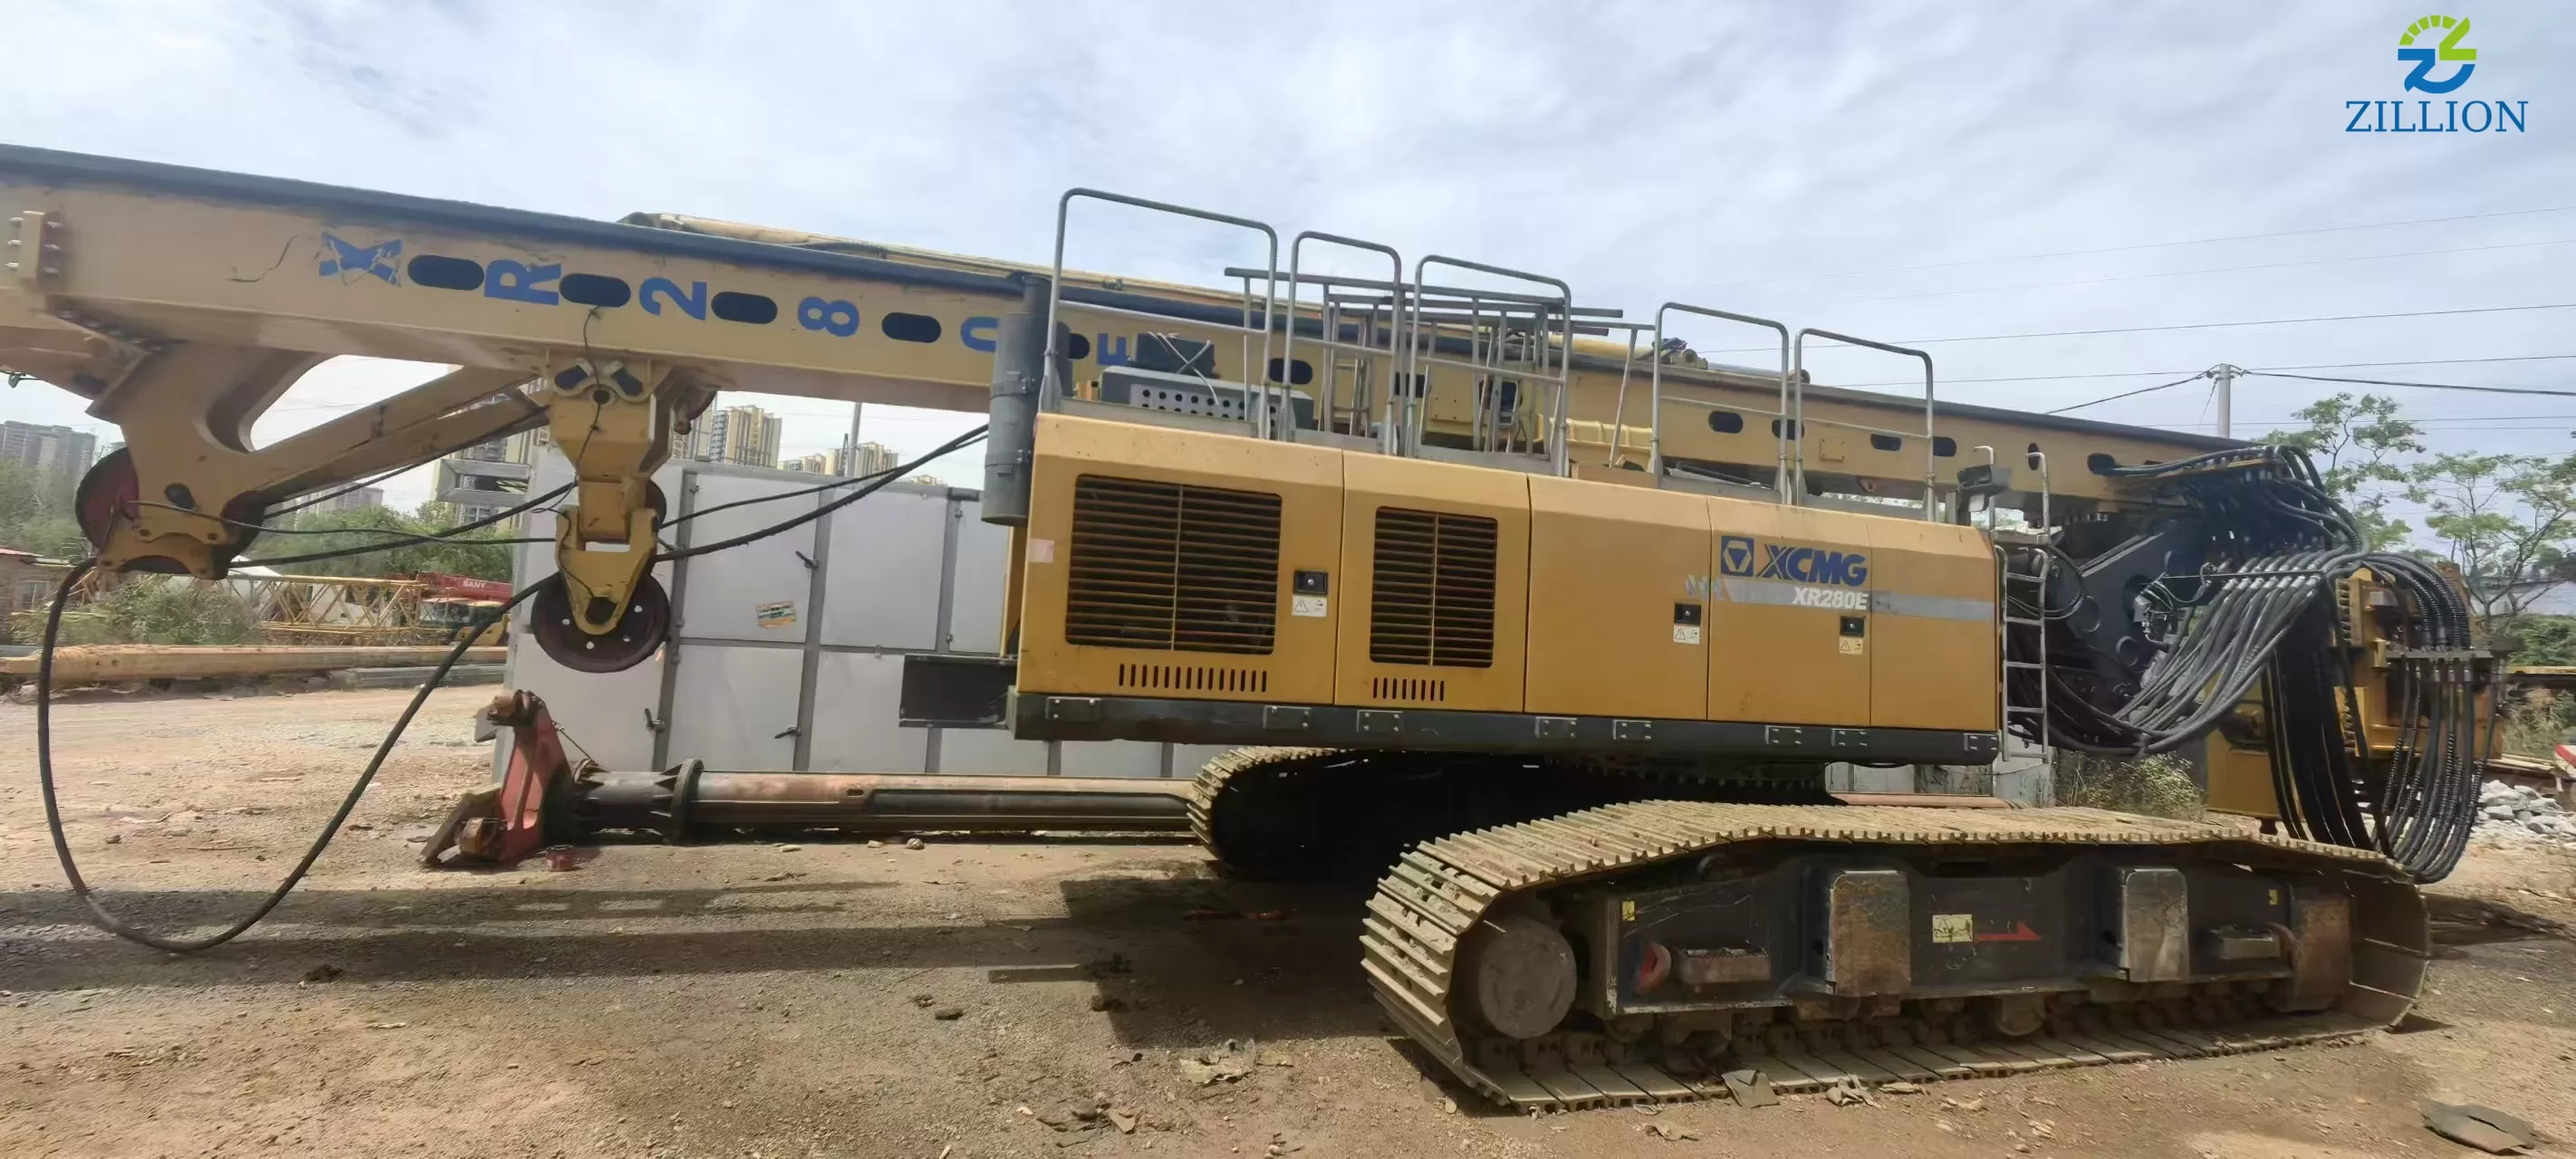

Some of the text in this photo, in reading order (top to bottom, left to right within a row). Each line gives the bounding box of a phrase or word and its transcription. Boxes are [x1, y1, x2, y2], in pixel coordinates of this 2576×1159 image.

[1756, 543, 1868, 587] XCMG
[462, 580, 486, 589] SANY
[1792, 586, 1869, 611] XR280E
